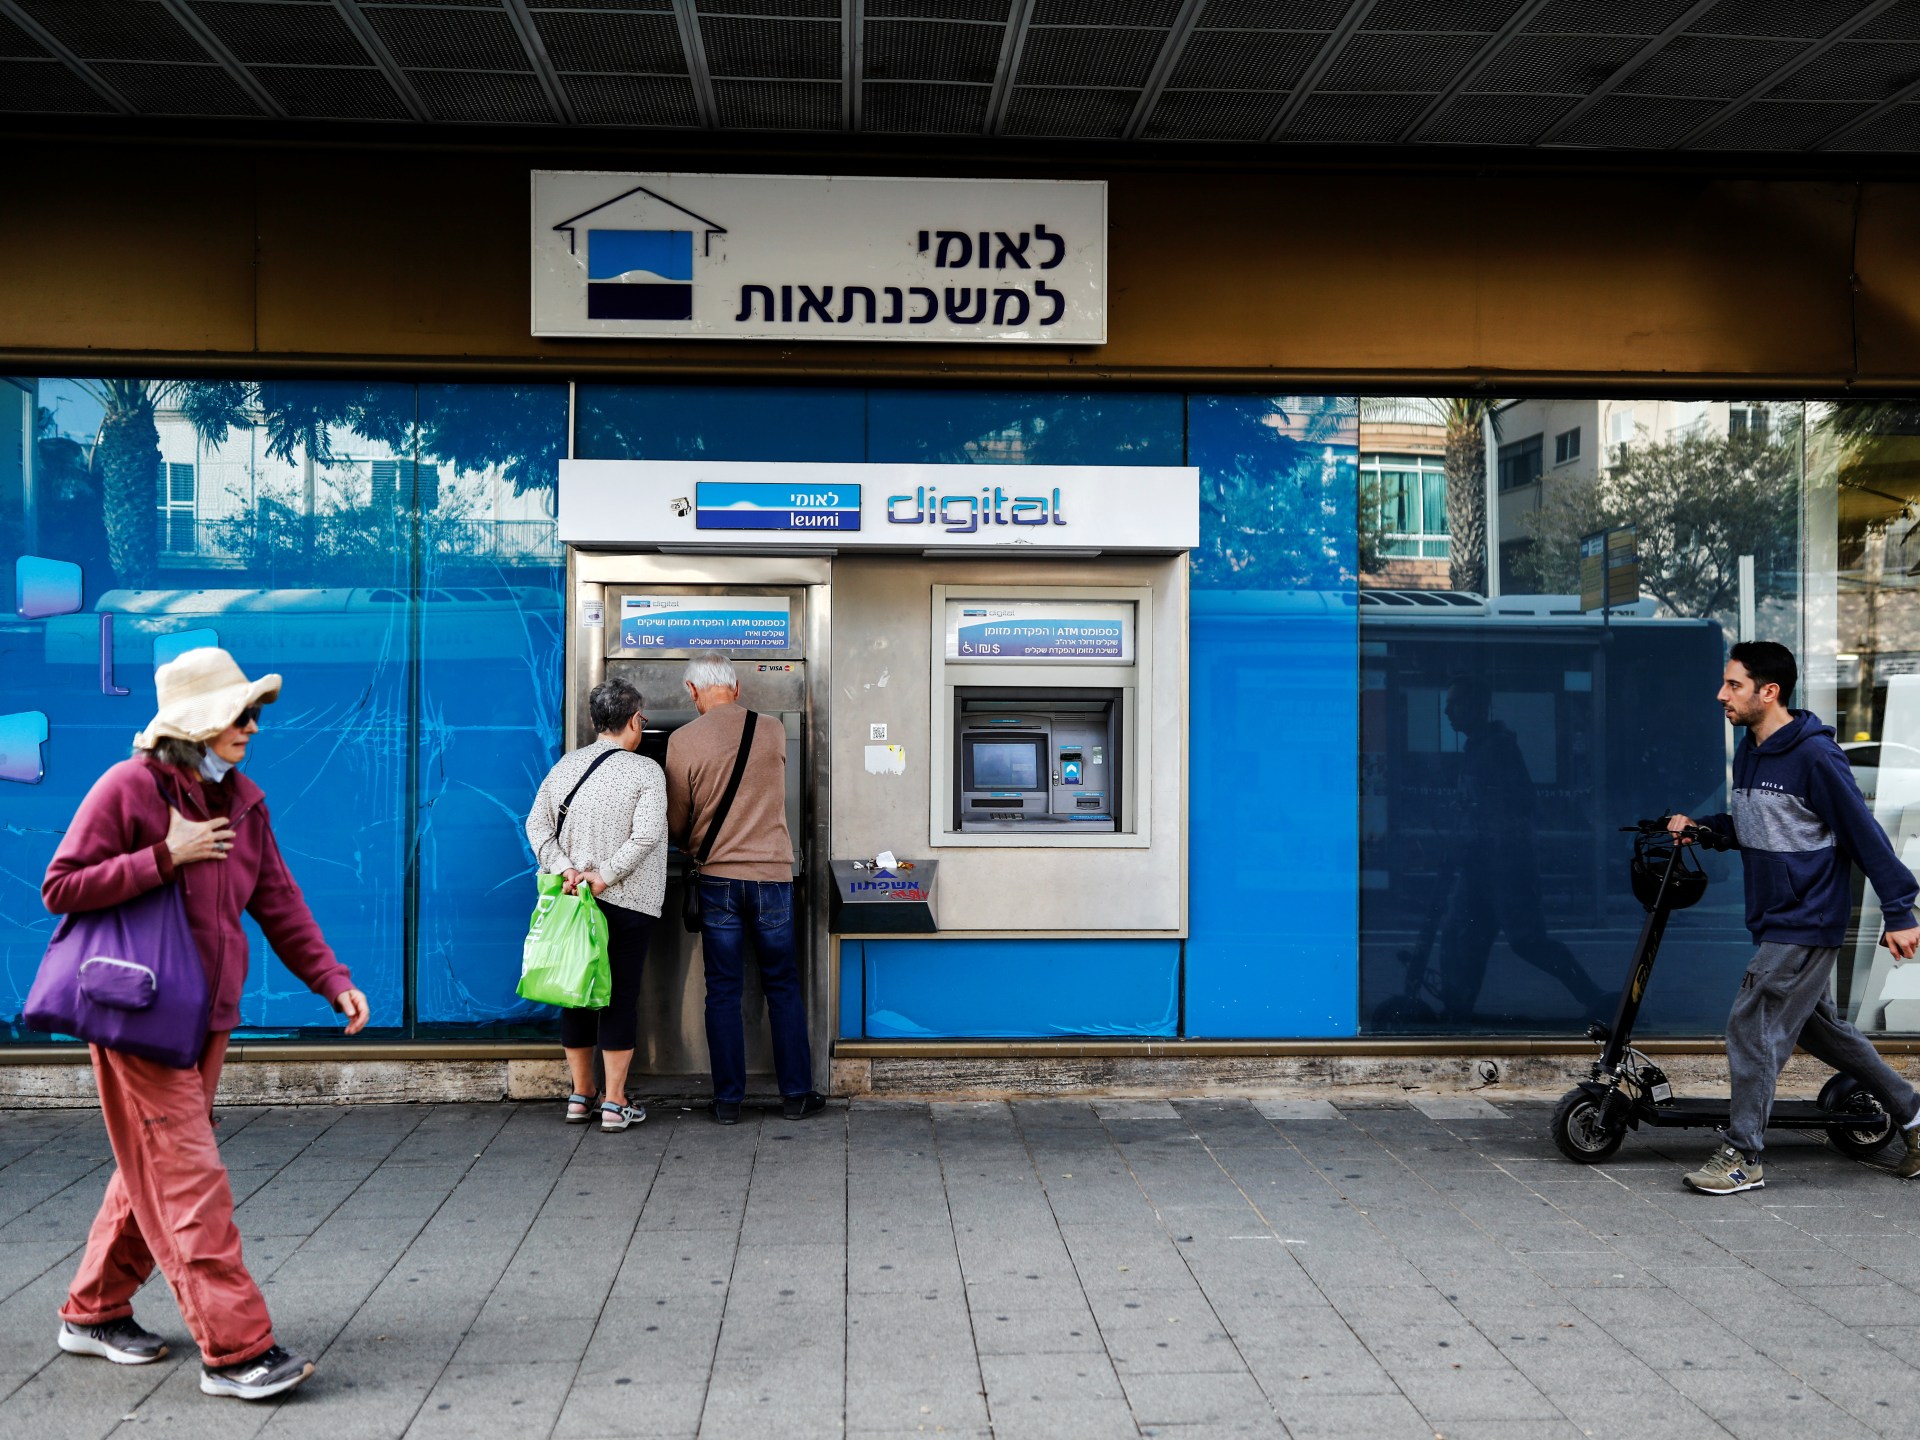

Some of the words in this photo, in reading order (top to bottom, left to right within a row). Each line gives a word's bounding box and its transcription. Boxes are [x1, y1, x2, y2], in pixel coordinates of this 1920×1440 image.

[918, 224, 1066, 270] לאומי
[735, 280, 1066, 326] למשכנתאות
[790, 491, 839, 506] לאומי
[888, 485, 1067, 533] digital
[790, 511, 839, 527] leumi
[989, 609, 1015, 617] digital
[667, 619, 691, 628] מזומן
[692, 619, 725, 628] הפקדת
[731, 619, 750, 627] ATM
[751, 619, 786, 627] כספומט
[984, 627, 1011, 637] מזומן
[1013, 627, 1050, 637] הפקדת
[1057, 627, 1079, 636] ATM
[1080, 627, 1119, 636] כספומט
[850, 881, 919, 893] אשפתון
